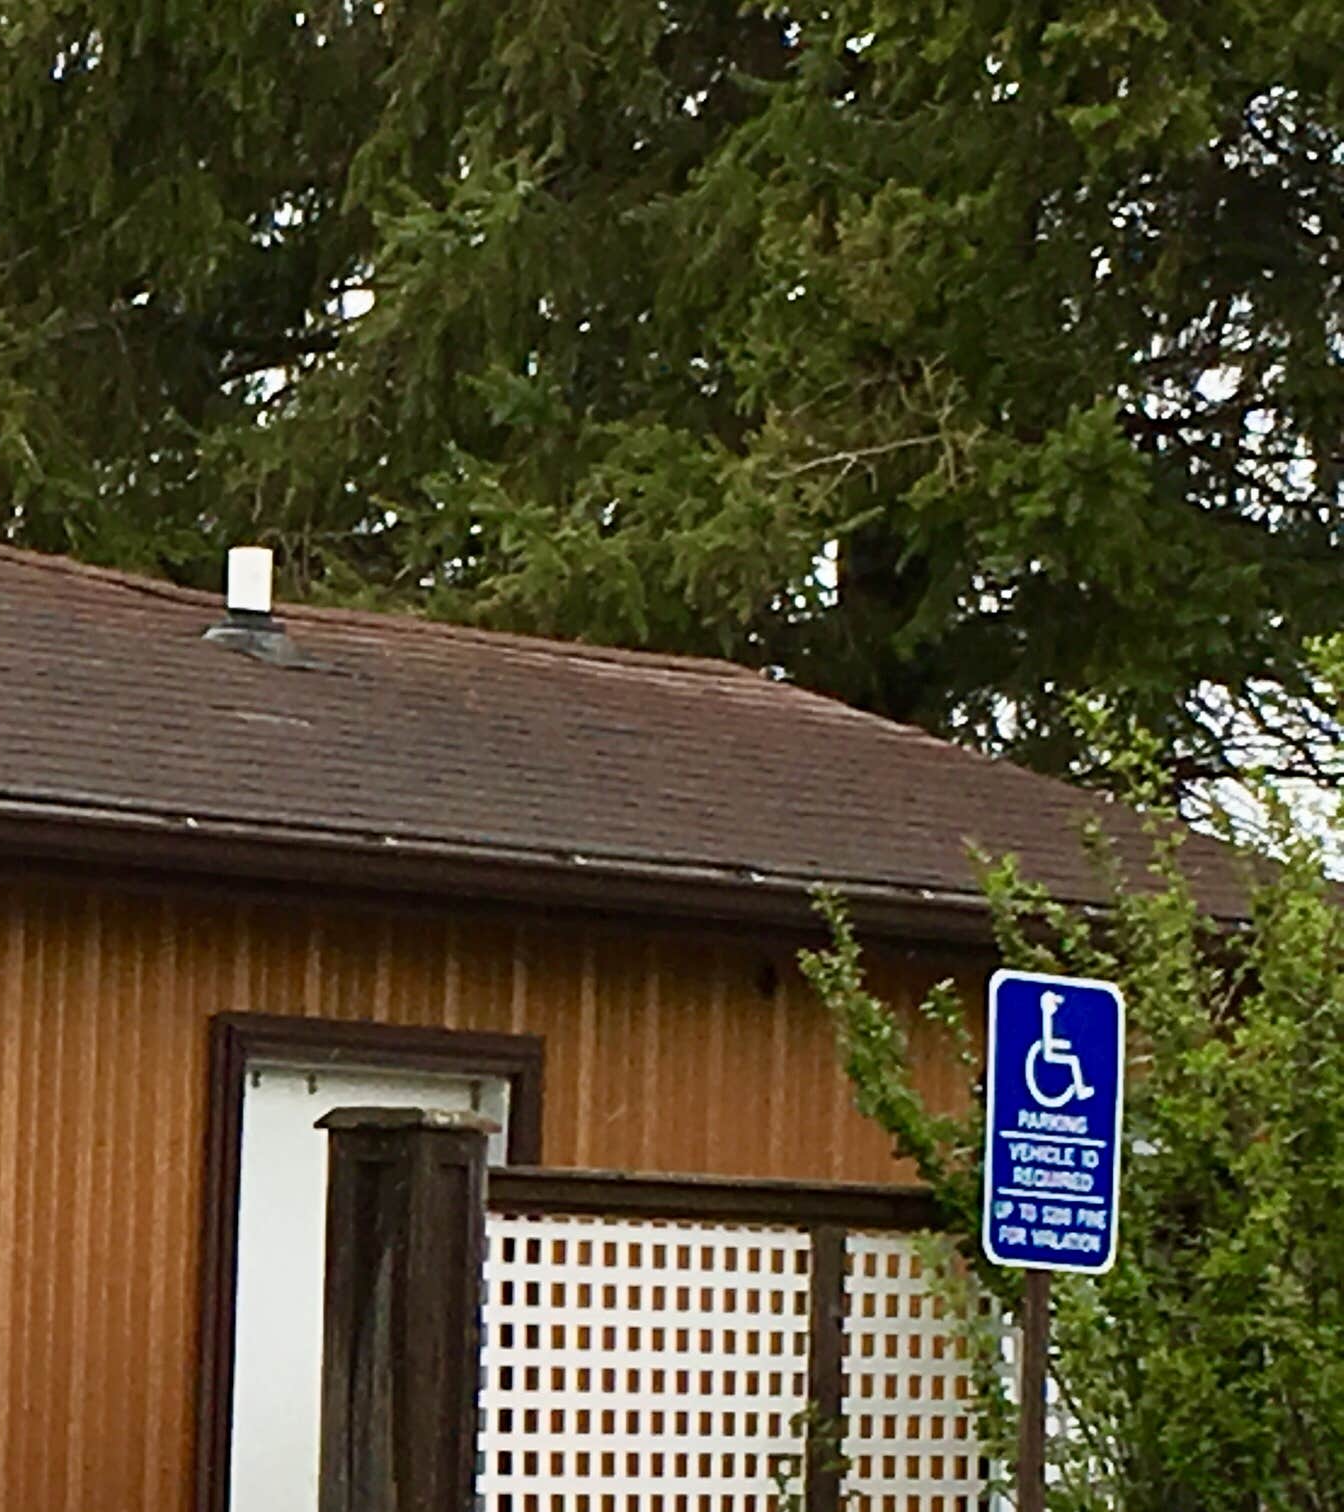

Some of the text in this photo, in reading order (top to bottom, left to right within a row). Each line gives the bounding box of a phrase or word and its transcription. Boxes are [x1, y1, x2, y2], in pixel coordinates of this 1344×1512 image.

[1017, 1109, 1088, 1134] PARKING
[1009, 1142, 1099, 1168] VEHICLE ID
[1013, 1166, 1094, 1192] REQUIRED
[994, 1200, 1014, 1219] UP
[1018, 1203, 1037, 1222] TO
[1076, 1208, 1107, 1230] FINE
[998, 1225, 1101, 1253] FOR VIOLATION
